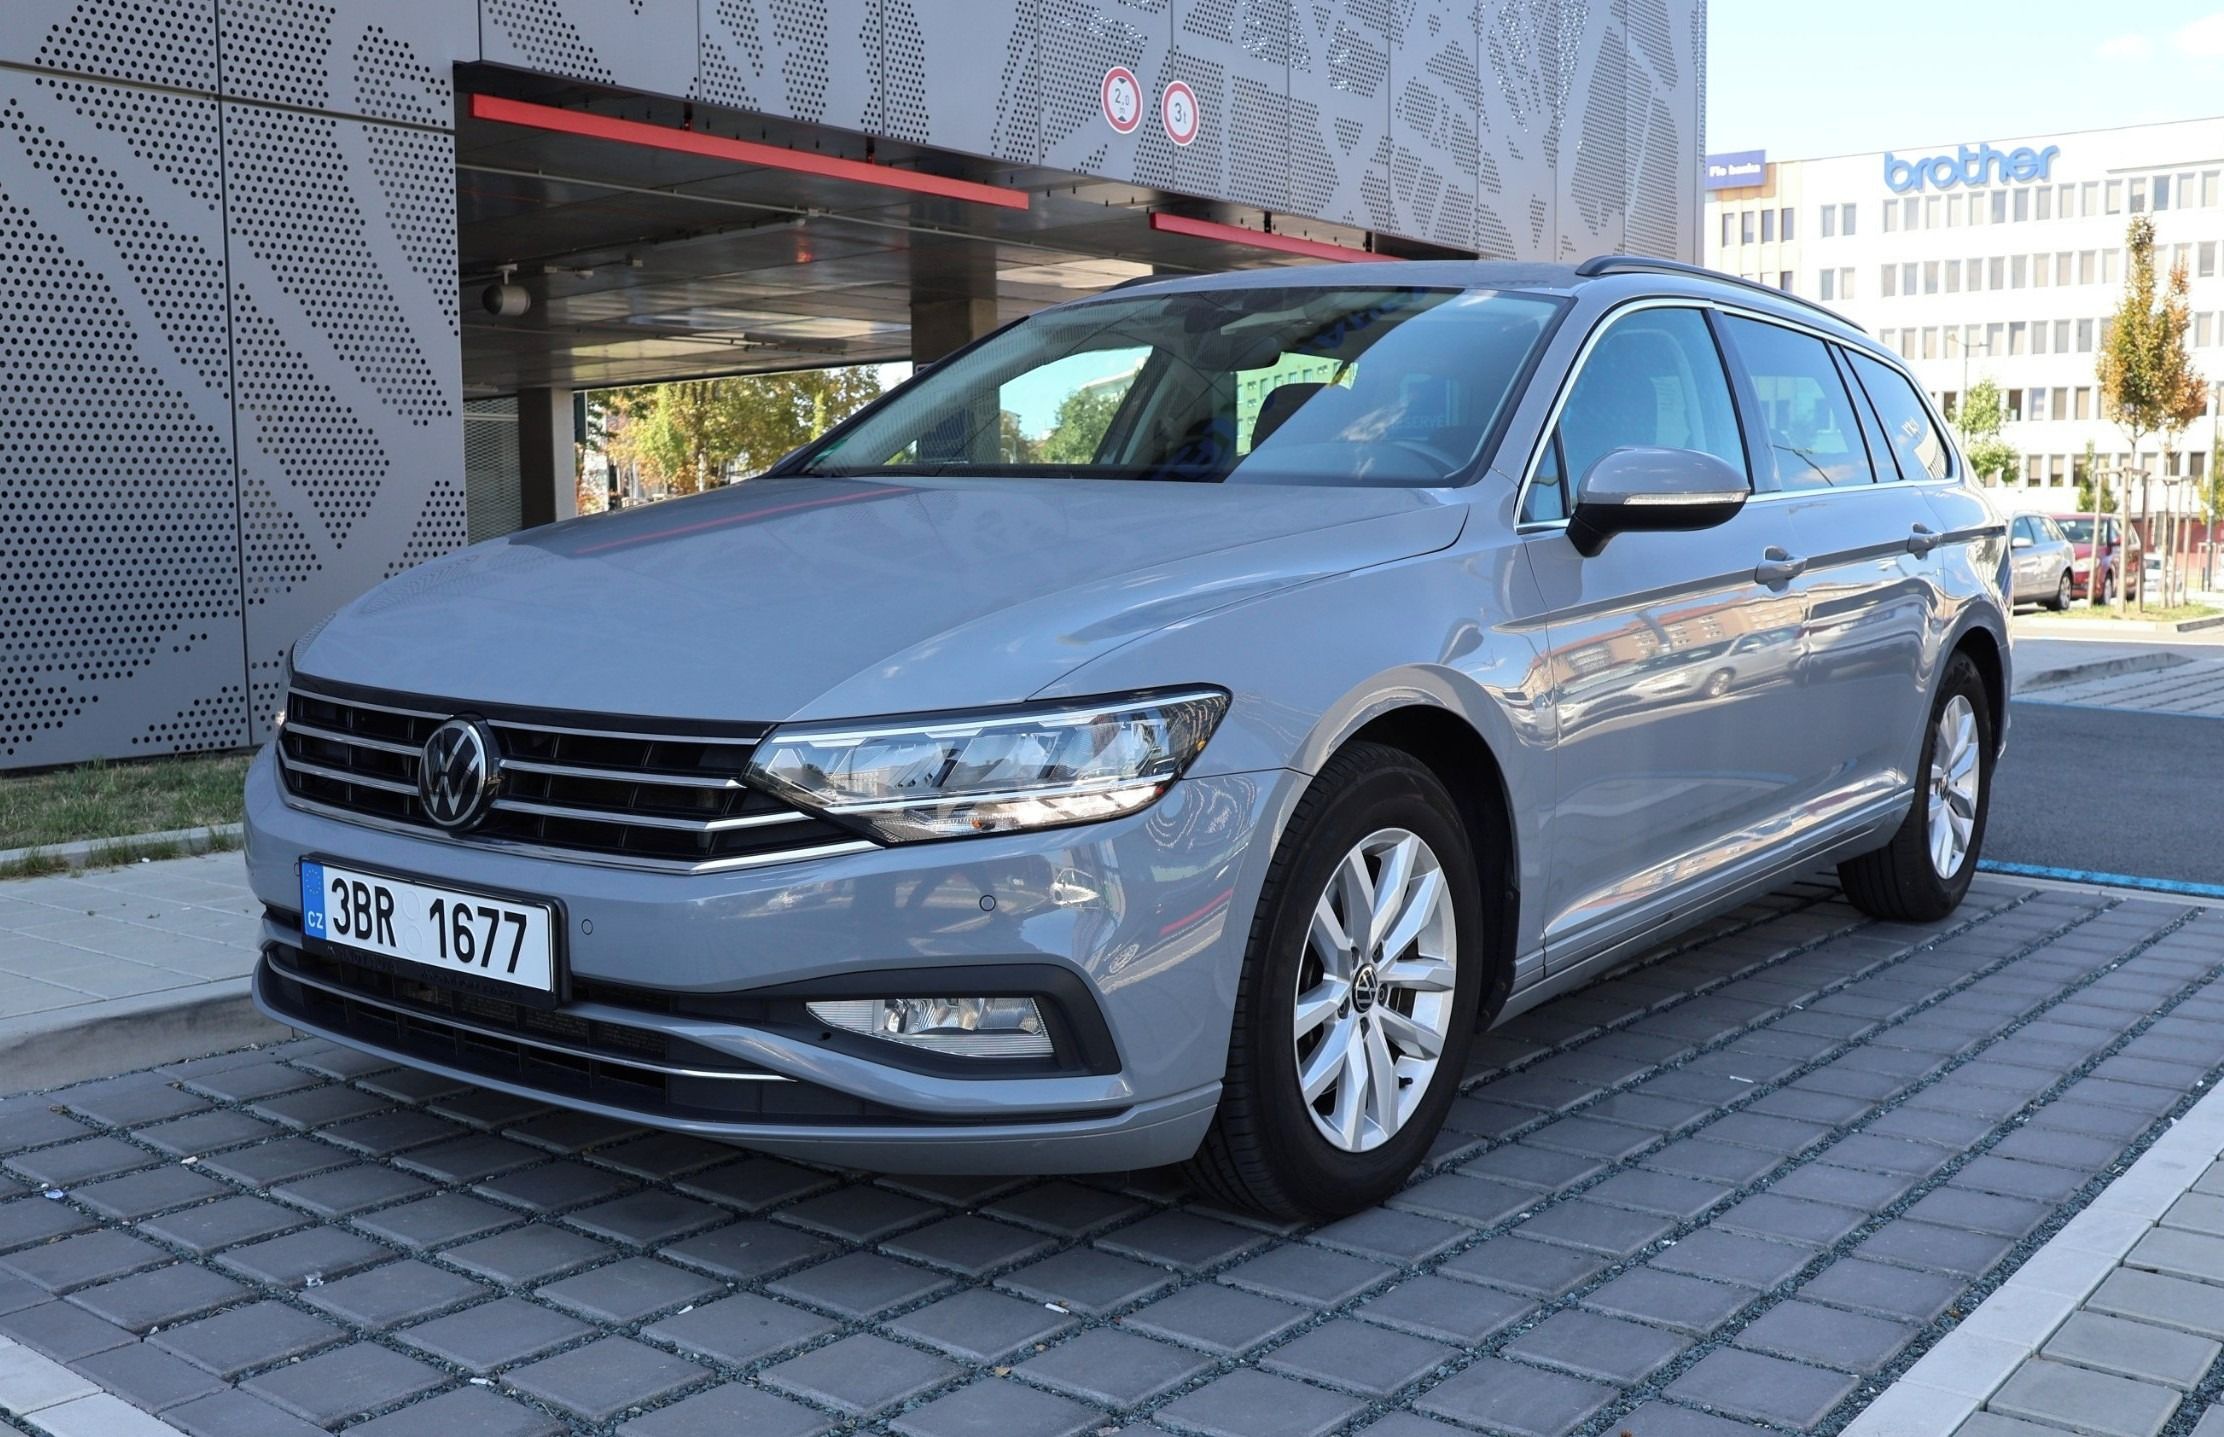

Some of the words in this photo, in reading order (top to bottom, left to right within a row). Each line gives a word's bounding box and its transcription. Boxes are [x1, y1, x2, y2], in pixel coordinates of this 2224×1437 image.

[1884, 143, 2061, 193] brother
[307, 911, 324, 930] CZ
[331, 877, 397, 947] 3BR
[429, 898, 527, 974] 1677
